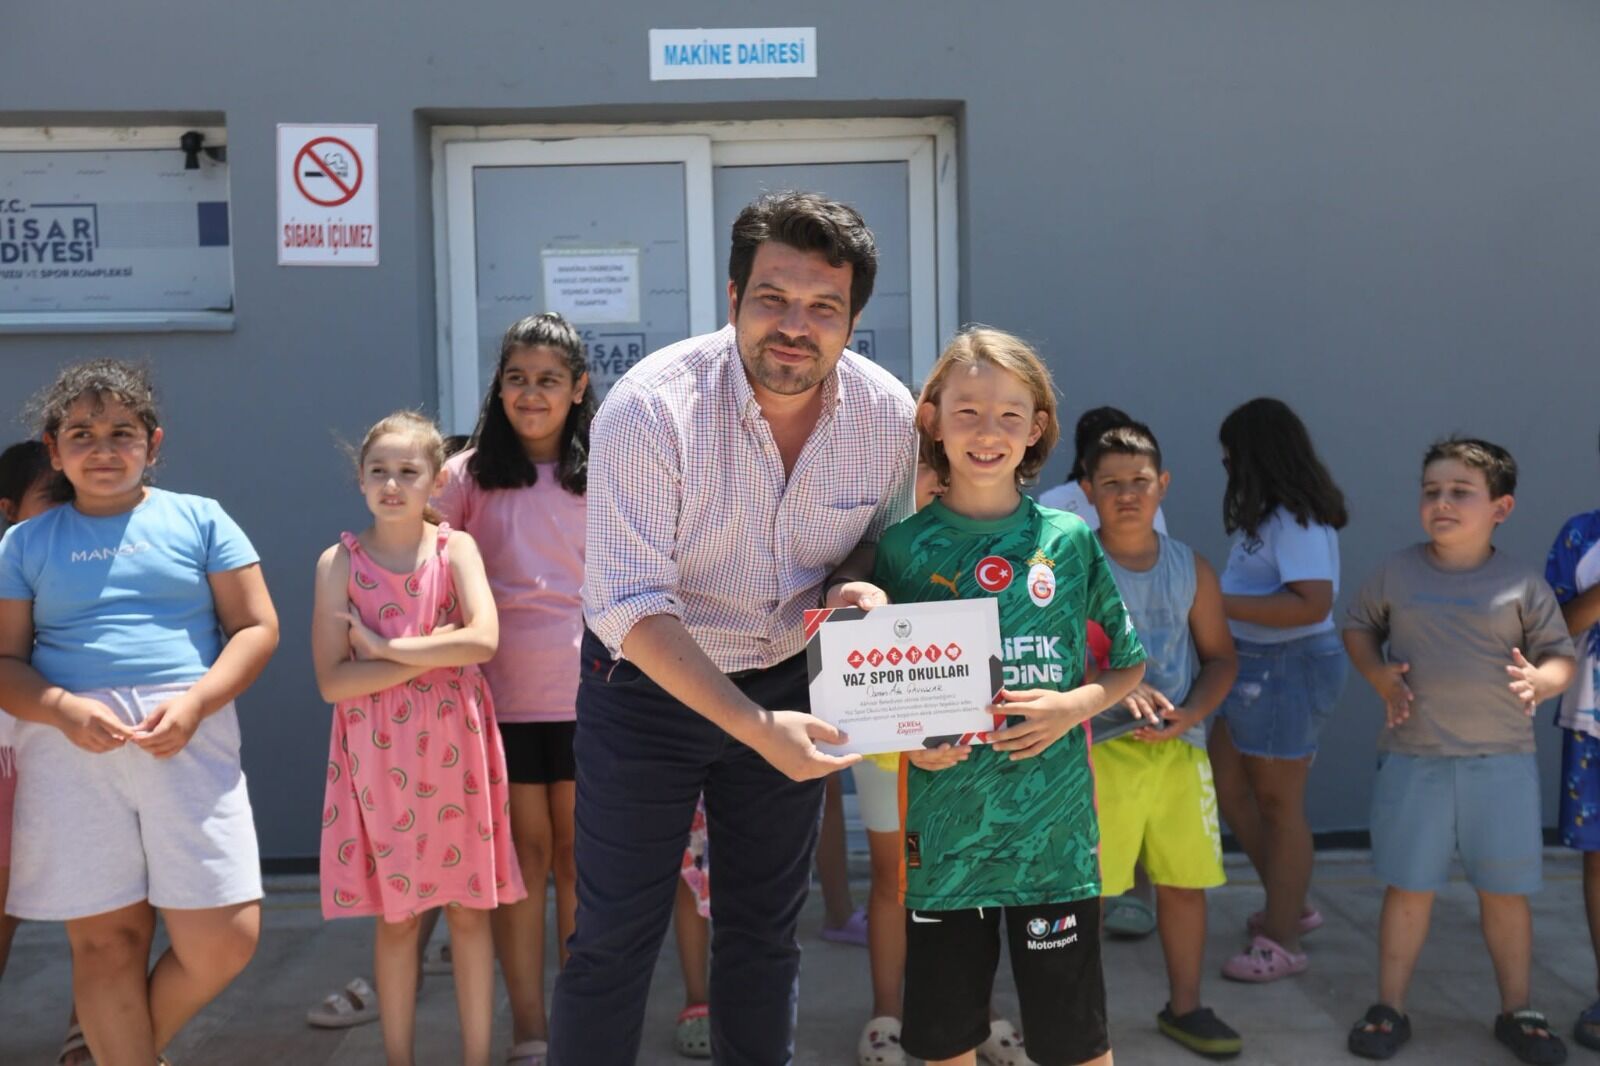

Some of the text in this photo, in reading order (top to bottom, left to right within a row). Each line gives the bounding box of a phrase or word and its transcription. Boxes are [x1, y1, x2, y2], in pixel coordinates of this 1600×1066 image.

[664, 38, 805, 65] MAKİNE DAİRESİ
[0, 218, 91, 240] İSAR
[284, 217, 372, 255] SİGARA İÇİLMEZ
[843, 664, 969, 687] YAZ SPOR OKULLARI
[1027, 933, 1078, 950] Motorsport
